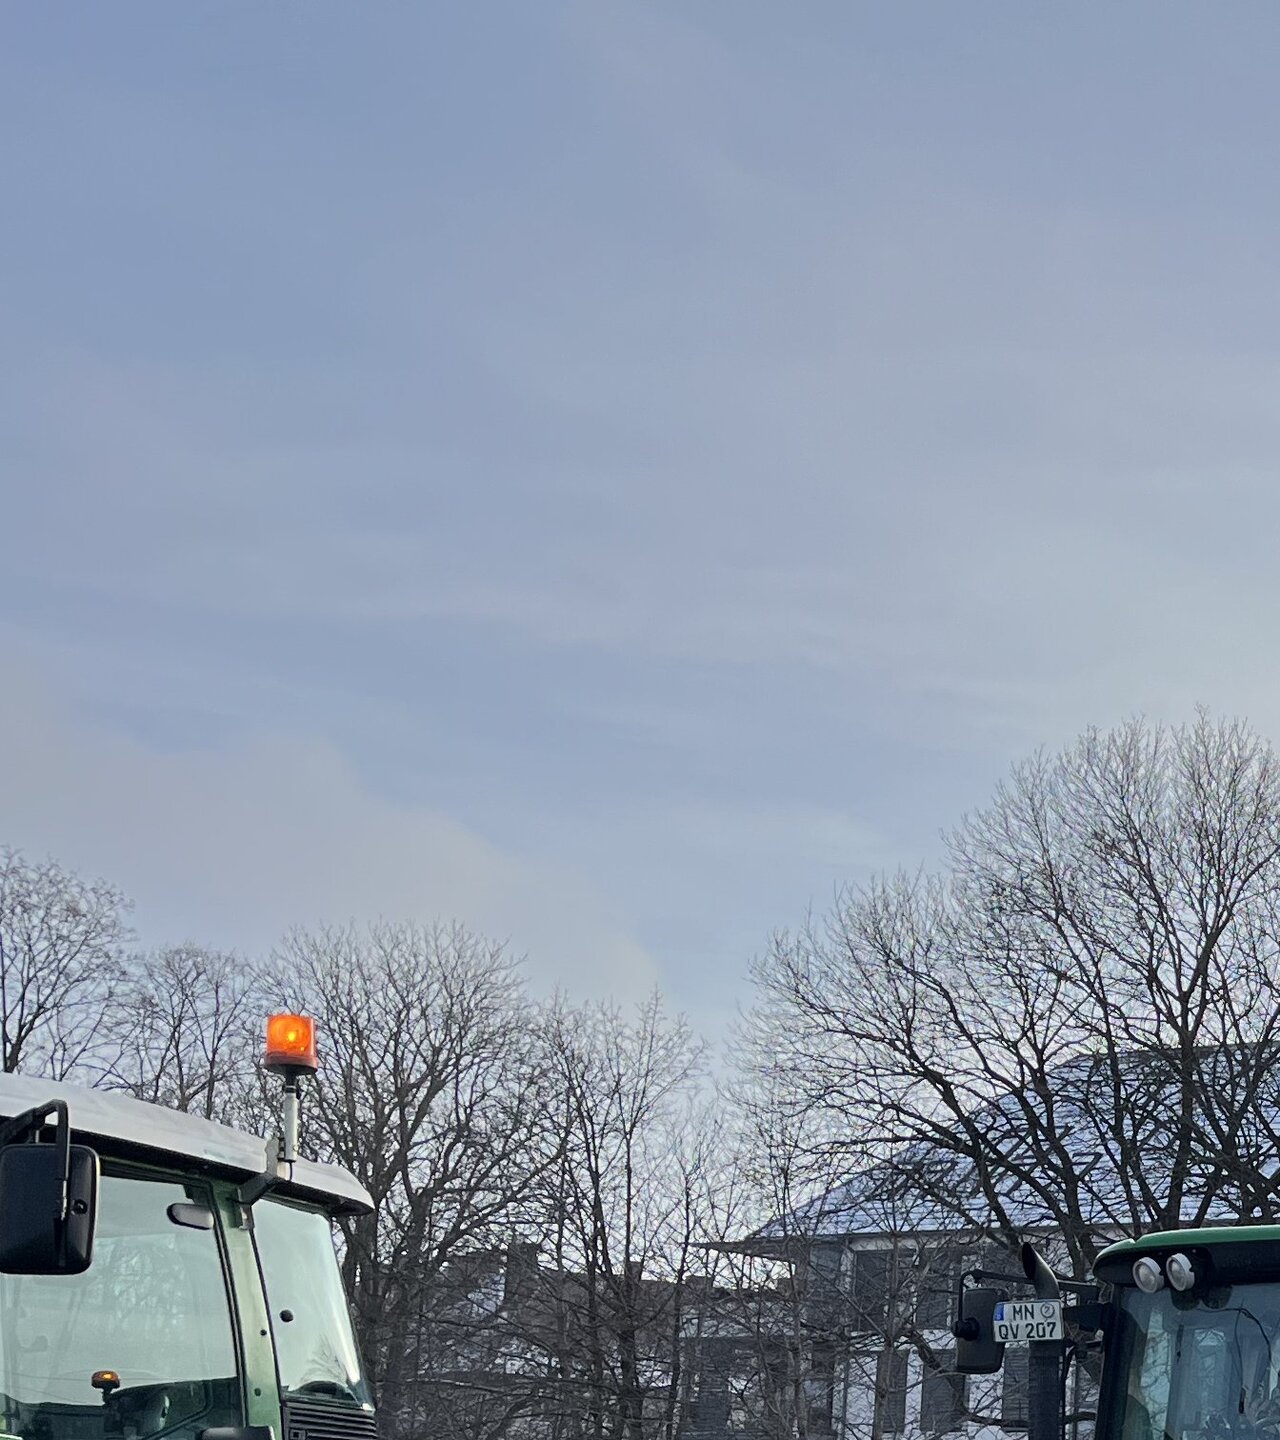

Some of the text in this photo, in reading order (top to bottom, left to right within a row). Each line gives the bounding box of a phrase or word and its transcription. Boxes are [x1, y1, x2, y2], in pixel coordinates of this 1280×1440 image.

[1012, 1304, 1034, 1320] MN
[998, 1322, 1056, 1339] QV 207
